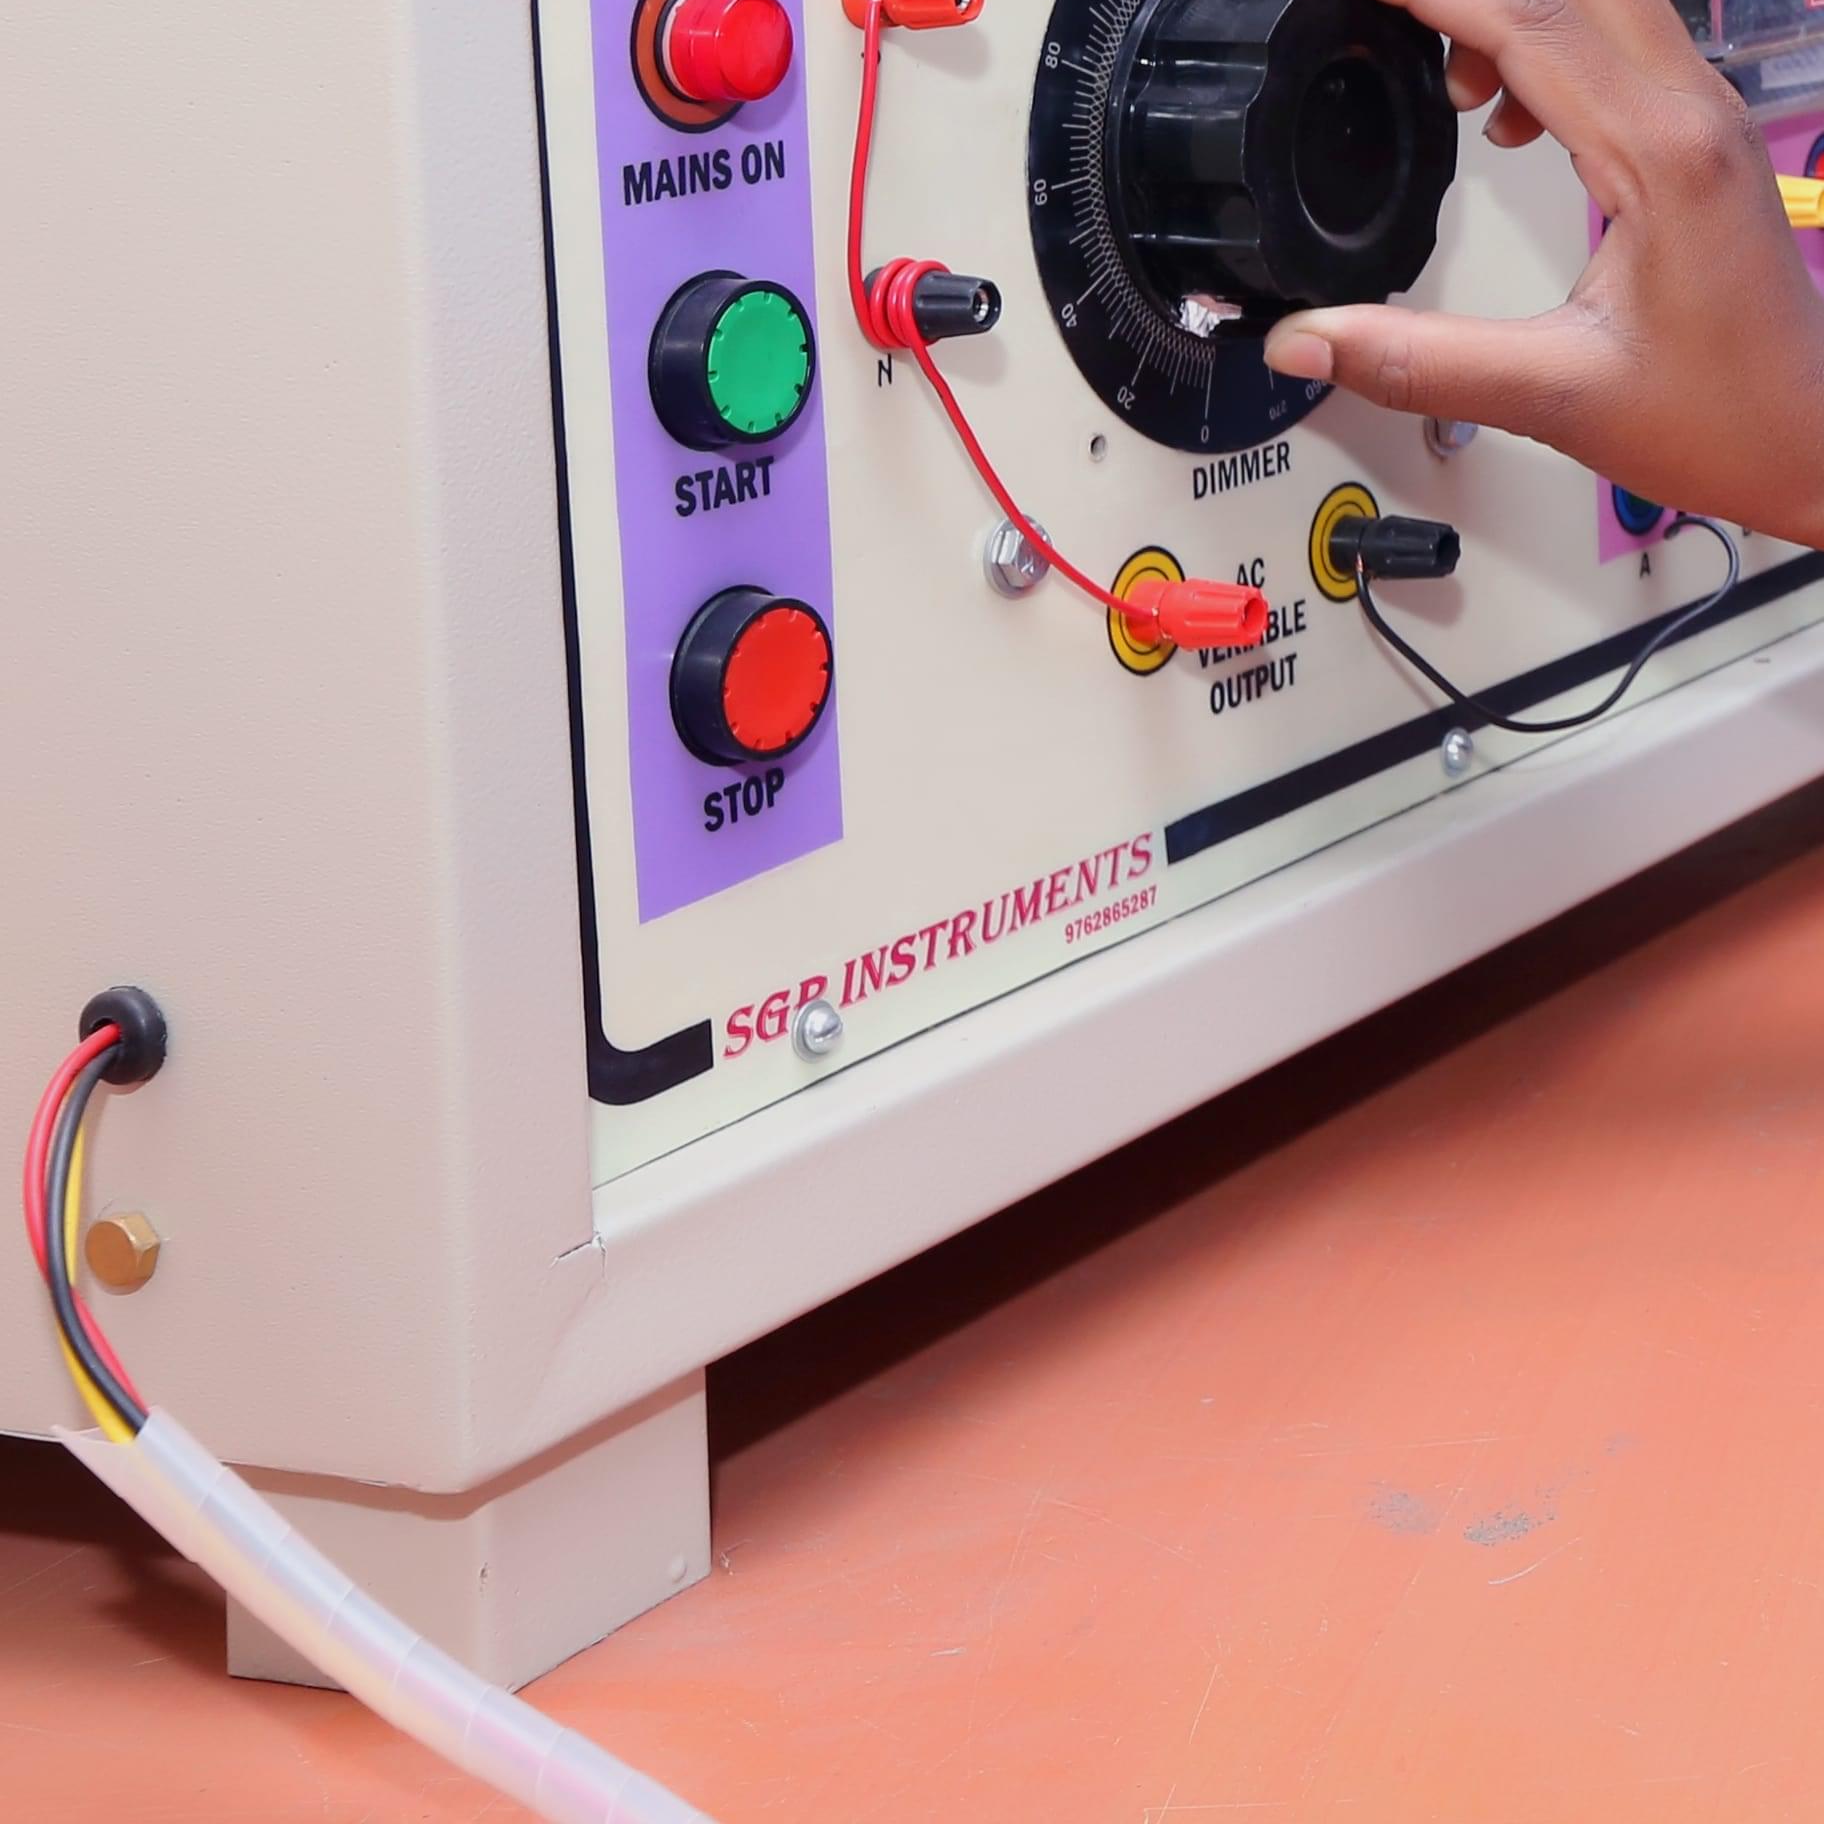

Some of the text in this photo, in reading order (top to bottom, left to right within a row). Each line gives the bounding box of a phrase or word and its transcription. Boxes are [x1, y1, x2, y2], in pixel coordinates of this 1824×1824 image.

[1045, 41, 1061, 69] 80
[623, 140, 785, 205] MAINS ON
[1033, 178, 1048, 206] 60
[1061, 303, 1078, 328] 40
[1117, 385, 1136, 410] 20
[675, 456, 774, 517] START
[1192, 441, 1291, 500] DIMMER
[1237, 557, 1265, 589] AC
[1210, 653, 1297, 714] OUTPUT
[704, 767, 785, 832] STOP
[840, 832, 1153, 1008] INSTRUMENTS
[1065, 885, 1157, 944] 9762865287
